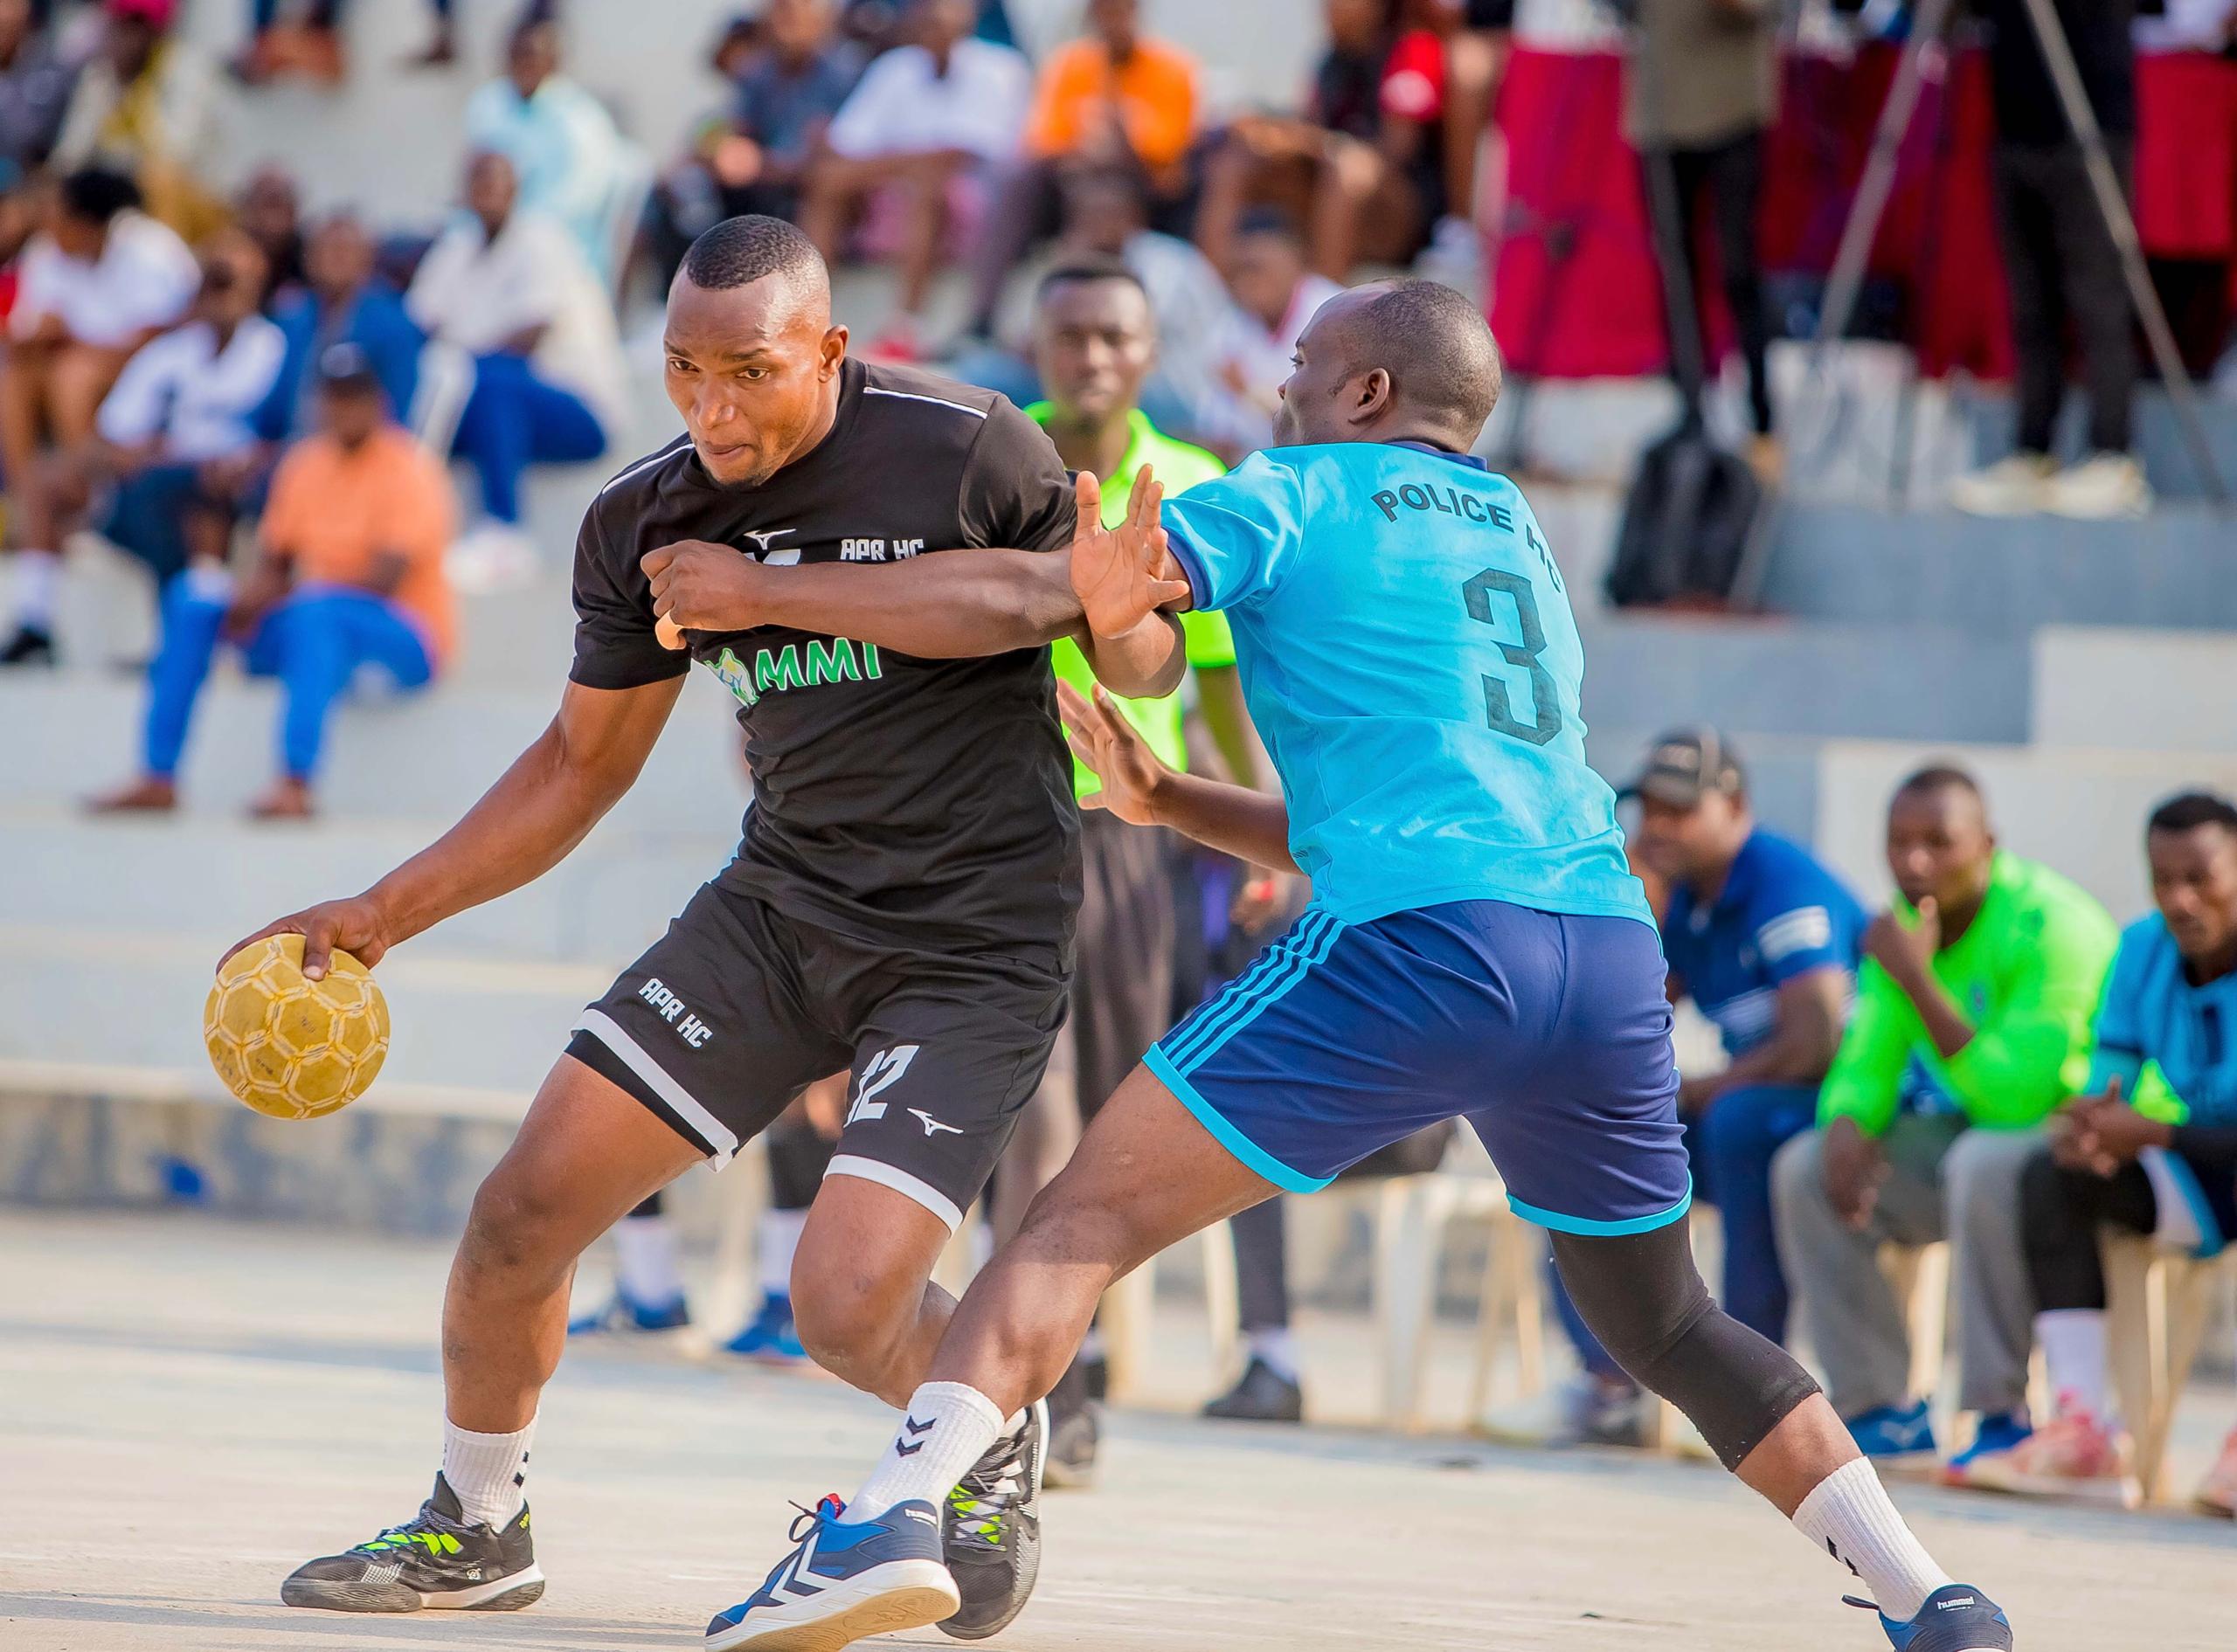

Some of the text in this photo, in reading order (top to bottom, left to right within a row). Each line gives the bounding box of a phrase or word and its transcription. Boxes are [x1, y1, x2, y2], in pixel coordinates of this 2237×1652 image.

[1370, 483, 1514, 533] POLICE
[840, 538, 925, 561] APR HC
[755, 637, 883, 692] MMI
[1462, 567, 1562, 746] 3
[638, 978, 713, 1047] APR HC
